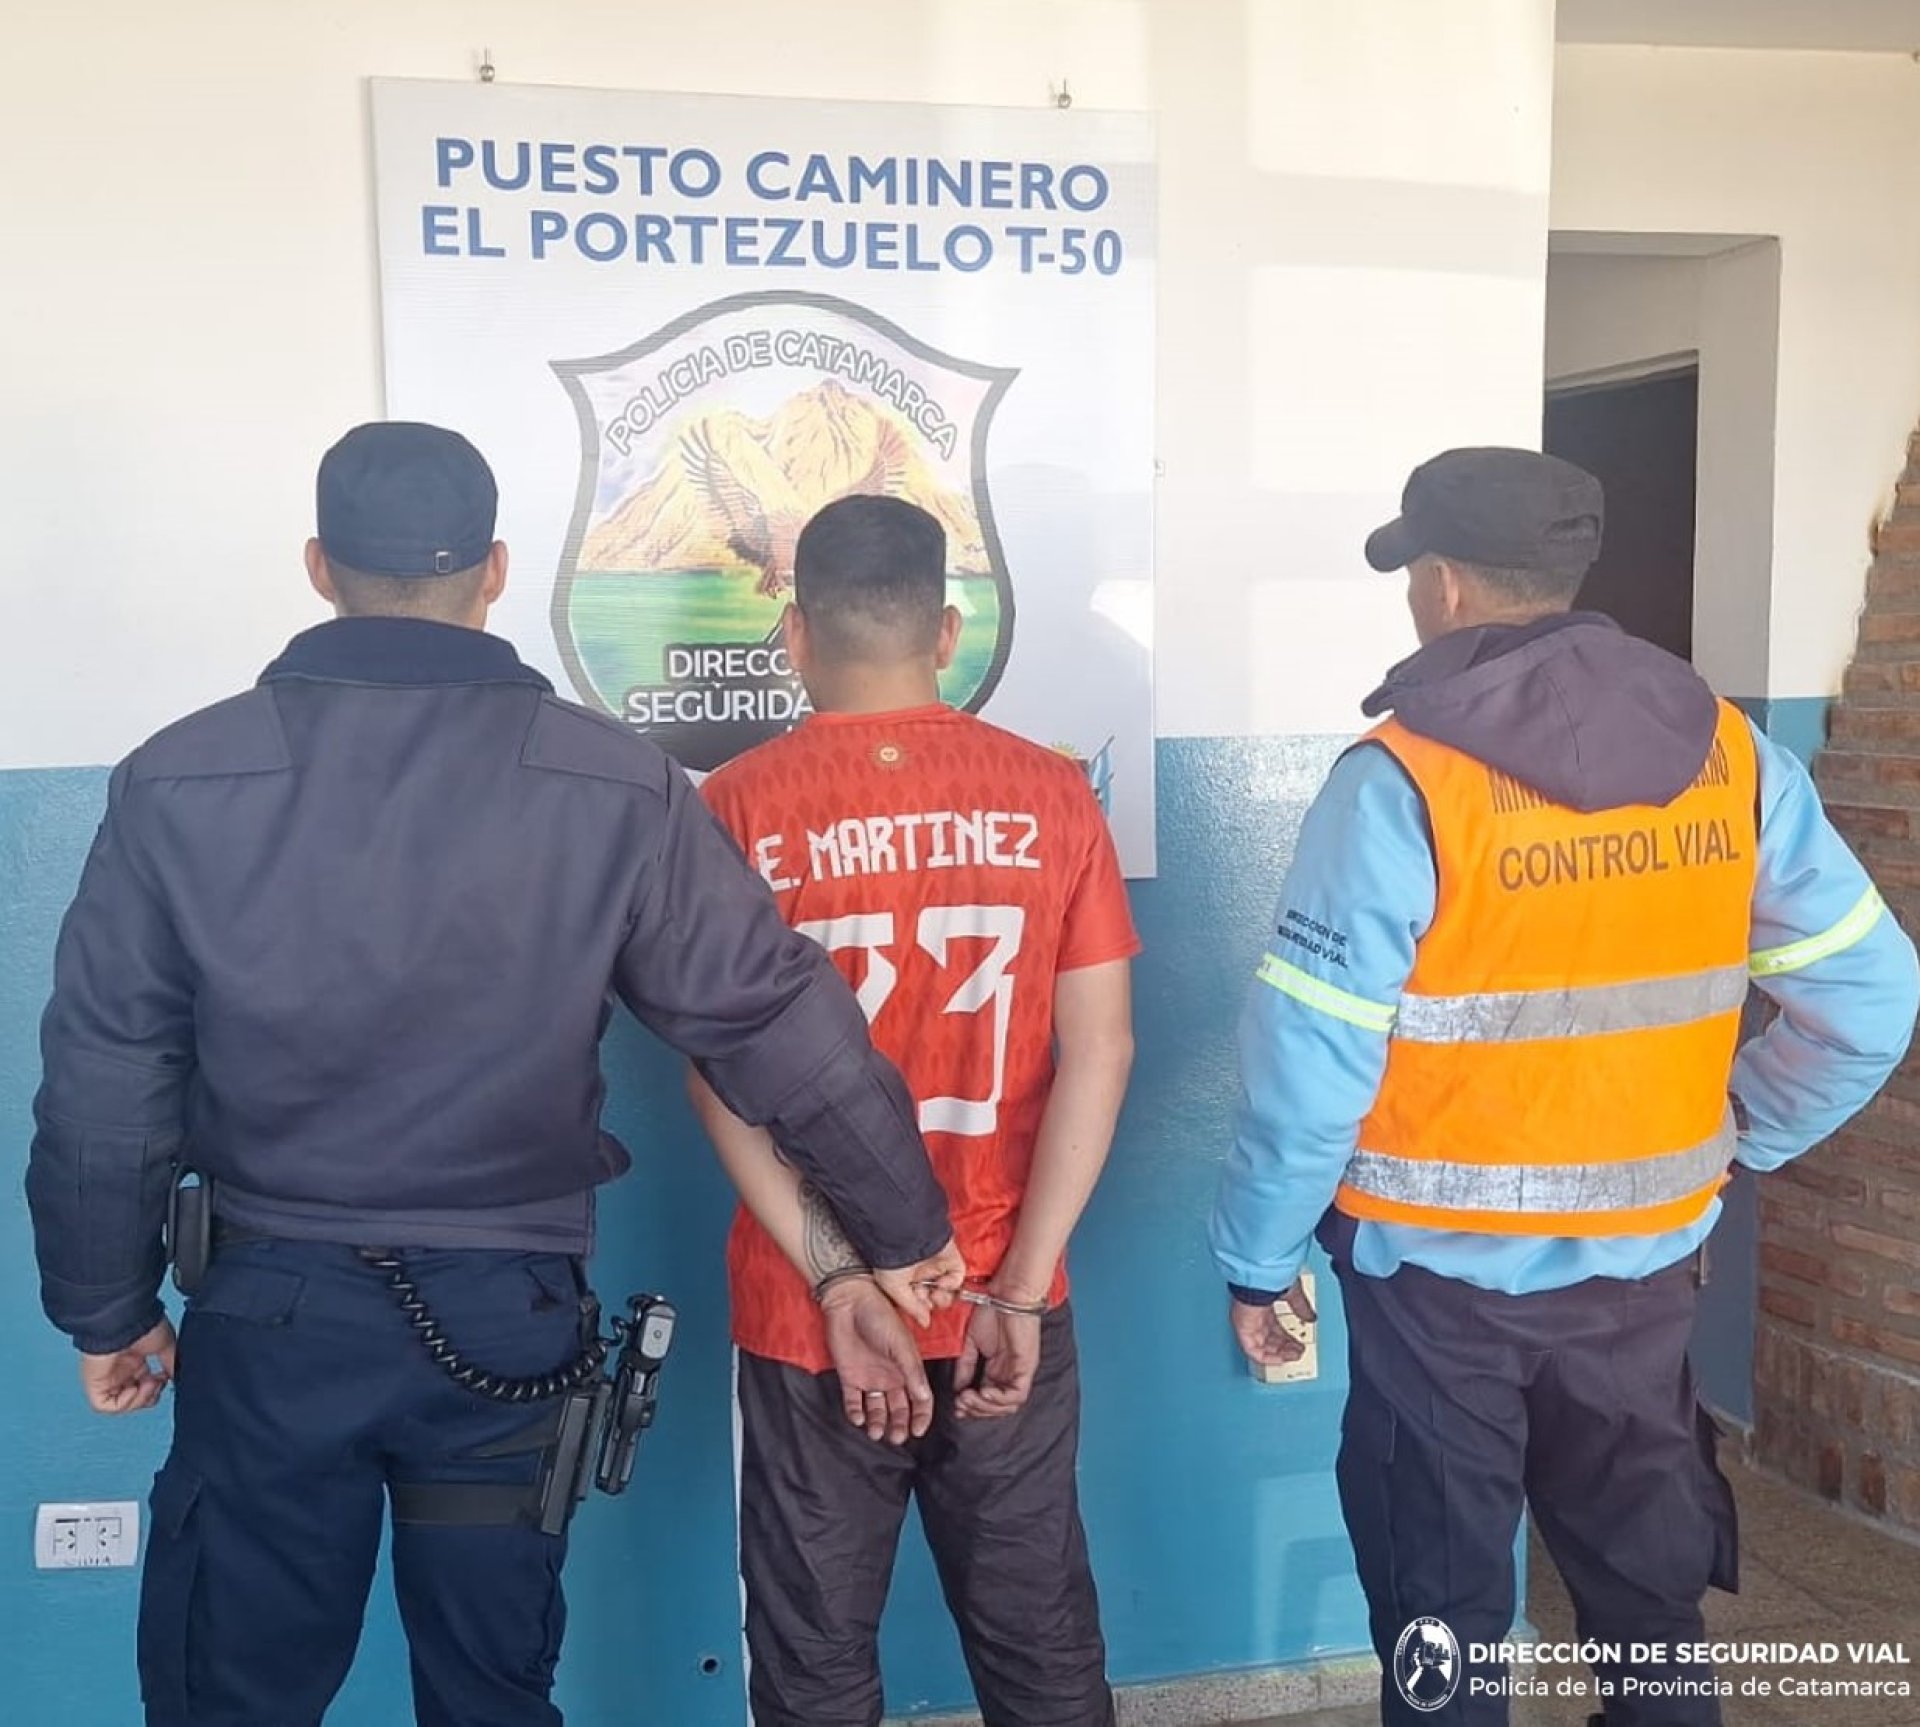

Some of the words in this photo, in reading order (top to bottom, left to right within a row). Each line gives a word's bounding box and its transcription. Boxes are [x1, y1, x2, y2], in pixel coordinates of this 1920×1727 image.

[435, 138, 721, 198] PUESTO
[746, 152, 1109, 212] CAMINERO
[421, 205, 505, 257] EL
[531, 210, 993, 273] PORTEZUELO
[1005, 226, 1123, 276] T-50
[605, 346, 727, 456] POLICIA
[725, 331, 773, 371] DE
[775, 330, 958, 460] CATAMARCA
[668, 648, 800, 678] DIRECC
[627, 688, 815, 723] SEGURIDA
[755, 834, 801, 892] E.
[806, 809, 1040, 882] MARTINEZ
[1500, 828, 1668, 890] CONTROL
[1675, 818, 1740, 867] VIAL
